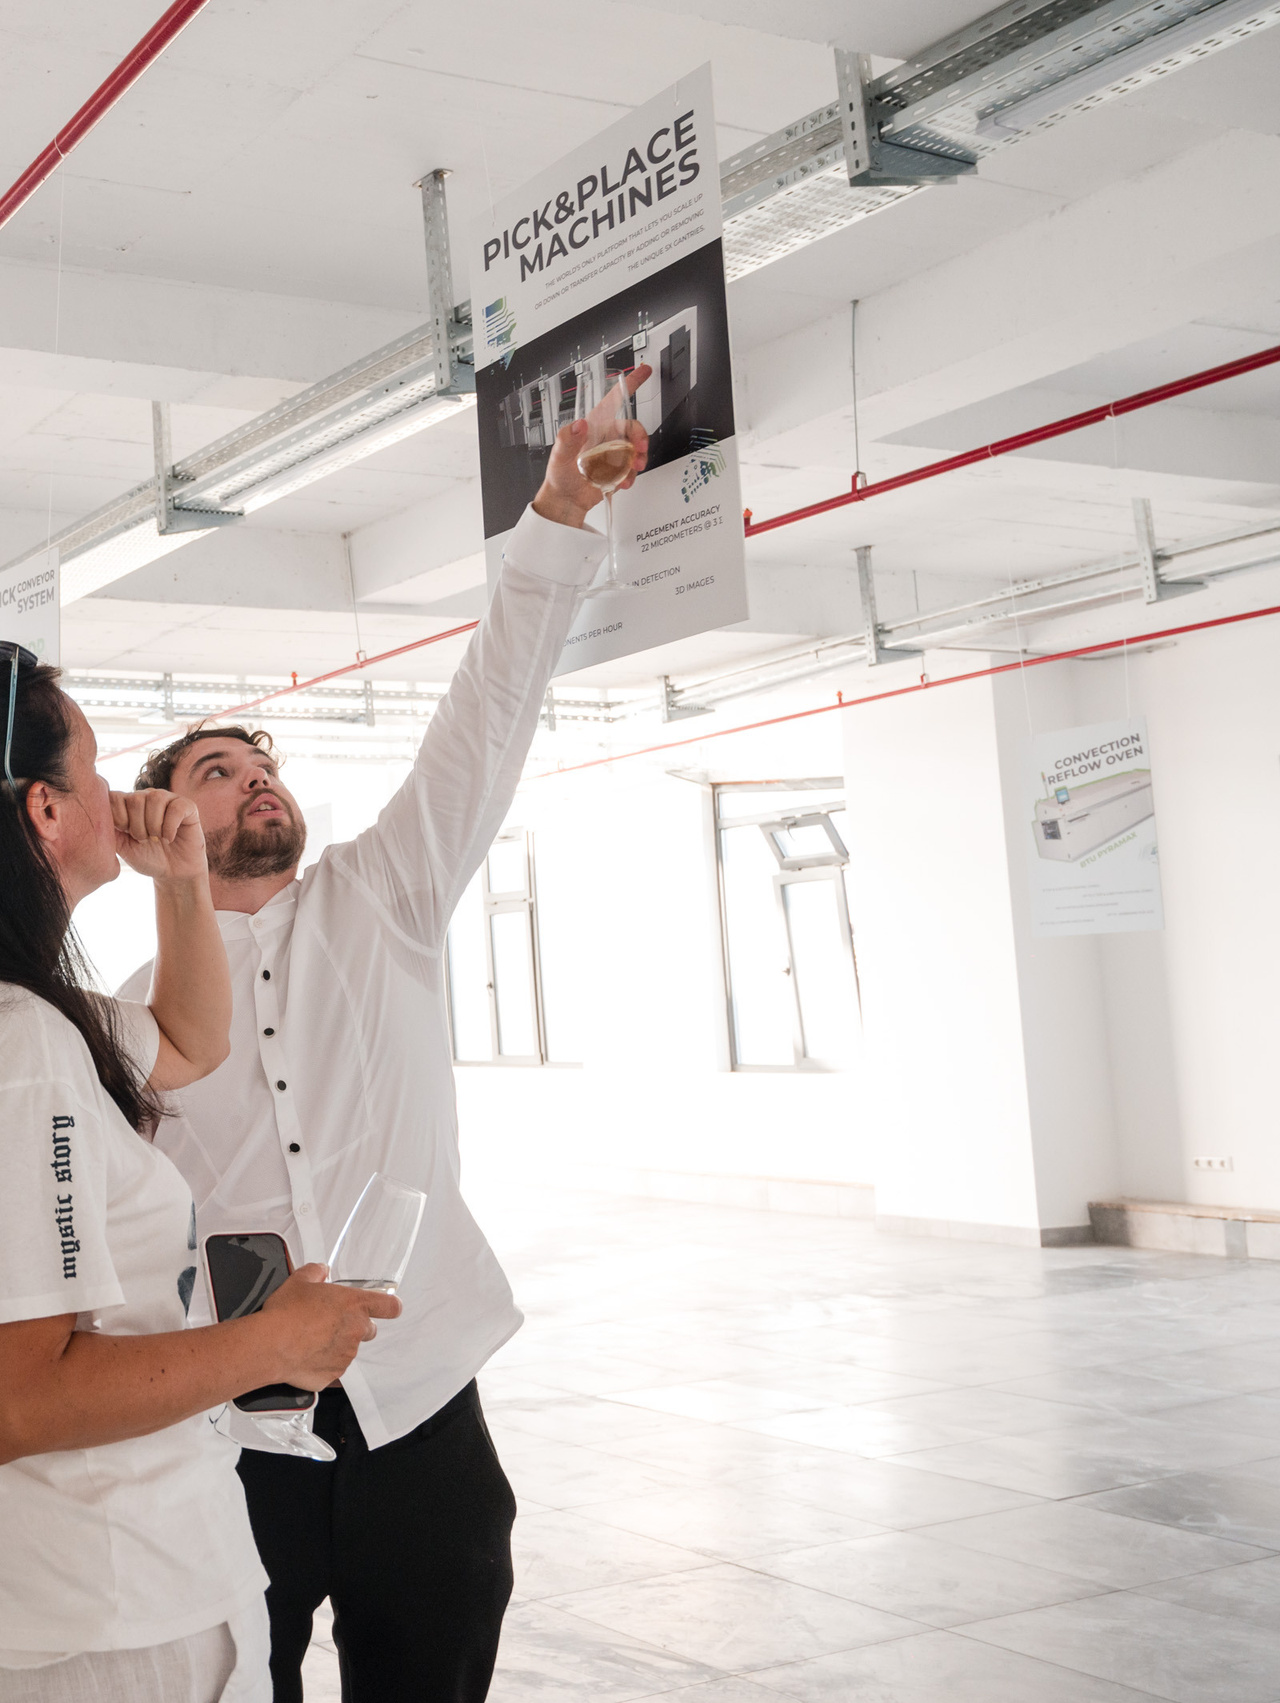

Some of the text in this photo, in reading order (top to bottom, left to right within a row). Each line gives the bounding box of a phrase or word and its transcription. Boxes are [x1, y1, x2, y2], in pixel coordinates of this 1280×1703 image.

[483, 109, 697, 272] PICK&PLACE
[520, 149, 700, 282] MACHINES
[535, 208, 704, 310] OR DOWN OR TRANSFER CAPACITY BY ADDING OR REMOVING
[545, 279, 556, 289] THE
[581, 256, 596, 268] ONLY
[597, 238, 628, 260] PLATFORM
[628, 228, 643, 240] THAT
[645, 220, 659, 232] LETS
[660, 211, 673, 223] YOU
[673, 199, 693, 215] SCALE
[694, 193, 703, 203] UP
[628, 262, 639, 272] THE
[640, 247, 663, 266] UNIQUE
[636, 504, 720, 542] PLACEMENT ACCURACY
[641, 544, 649, 552] 22
[651, 523, 703, 549] MICROMETERS
[704, 520, 712, 530] @
[713, 518, 717, 526] 3
[17, 569, 54, 593] CONVEYOR
[641, 566, 680, 586] DETECTION
[675, 575, 714, 595] 3D IMAGES
[17, 586, 54, 614] SYSTEM
[589, 628, 601, 639] PER
[603, 622, 622, 634] HOUR
[1048, 746, 1143, 785] REFLOW OVEN
[1055, 733, 1140, 769] CONVECTION
[1080, 832, 1137, 868] BTU PYRAMAX
[50, 1115, 80, 1279] mystic story
